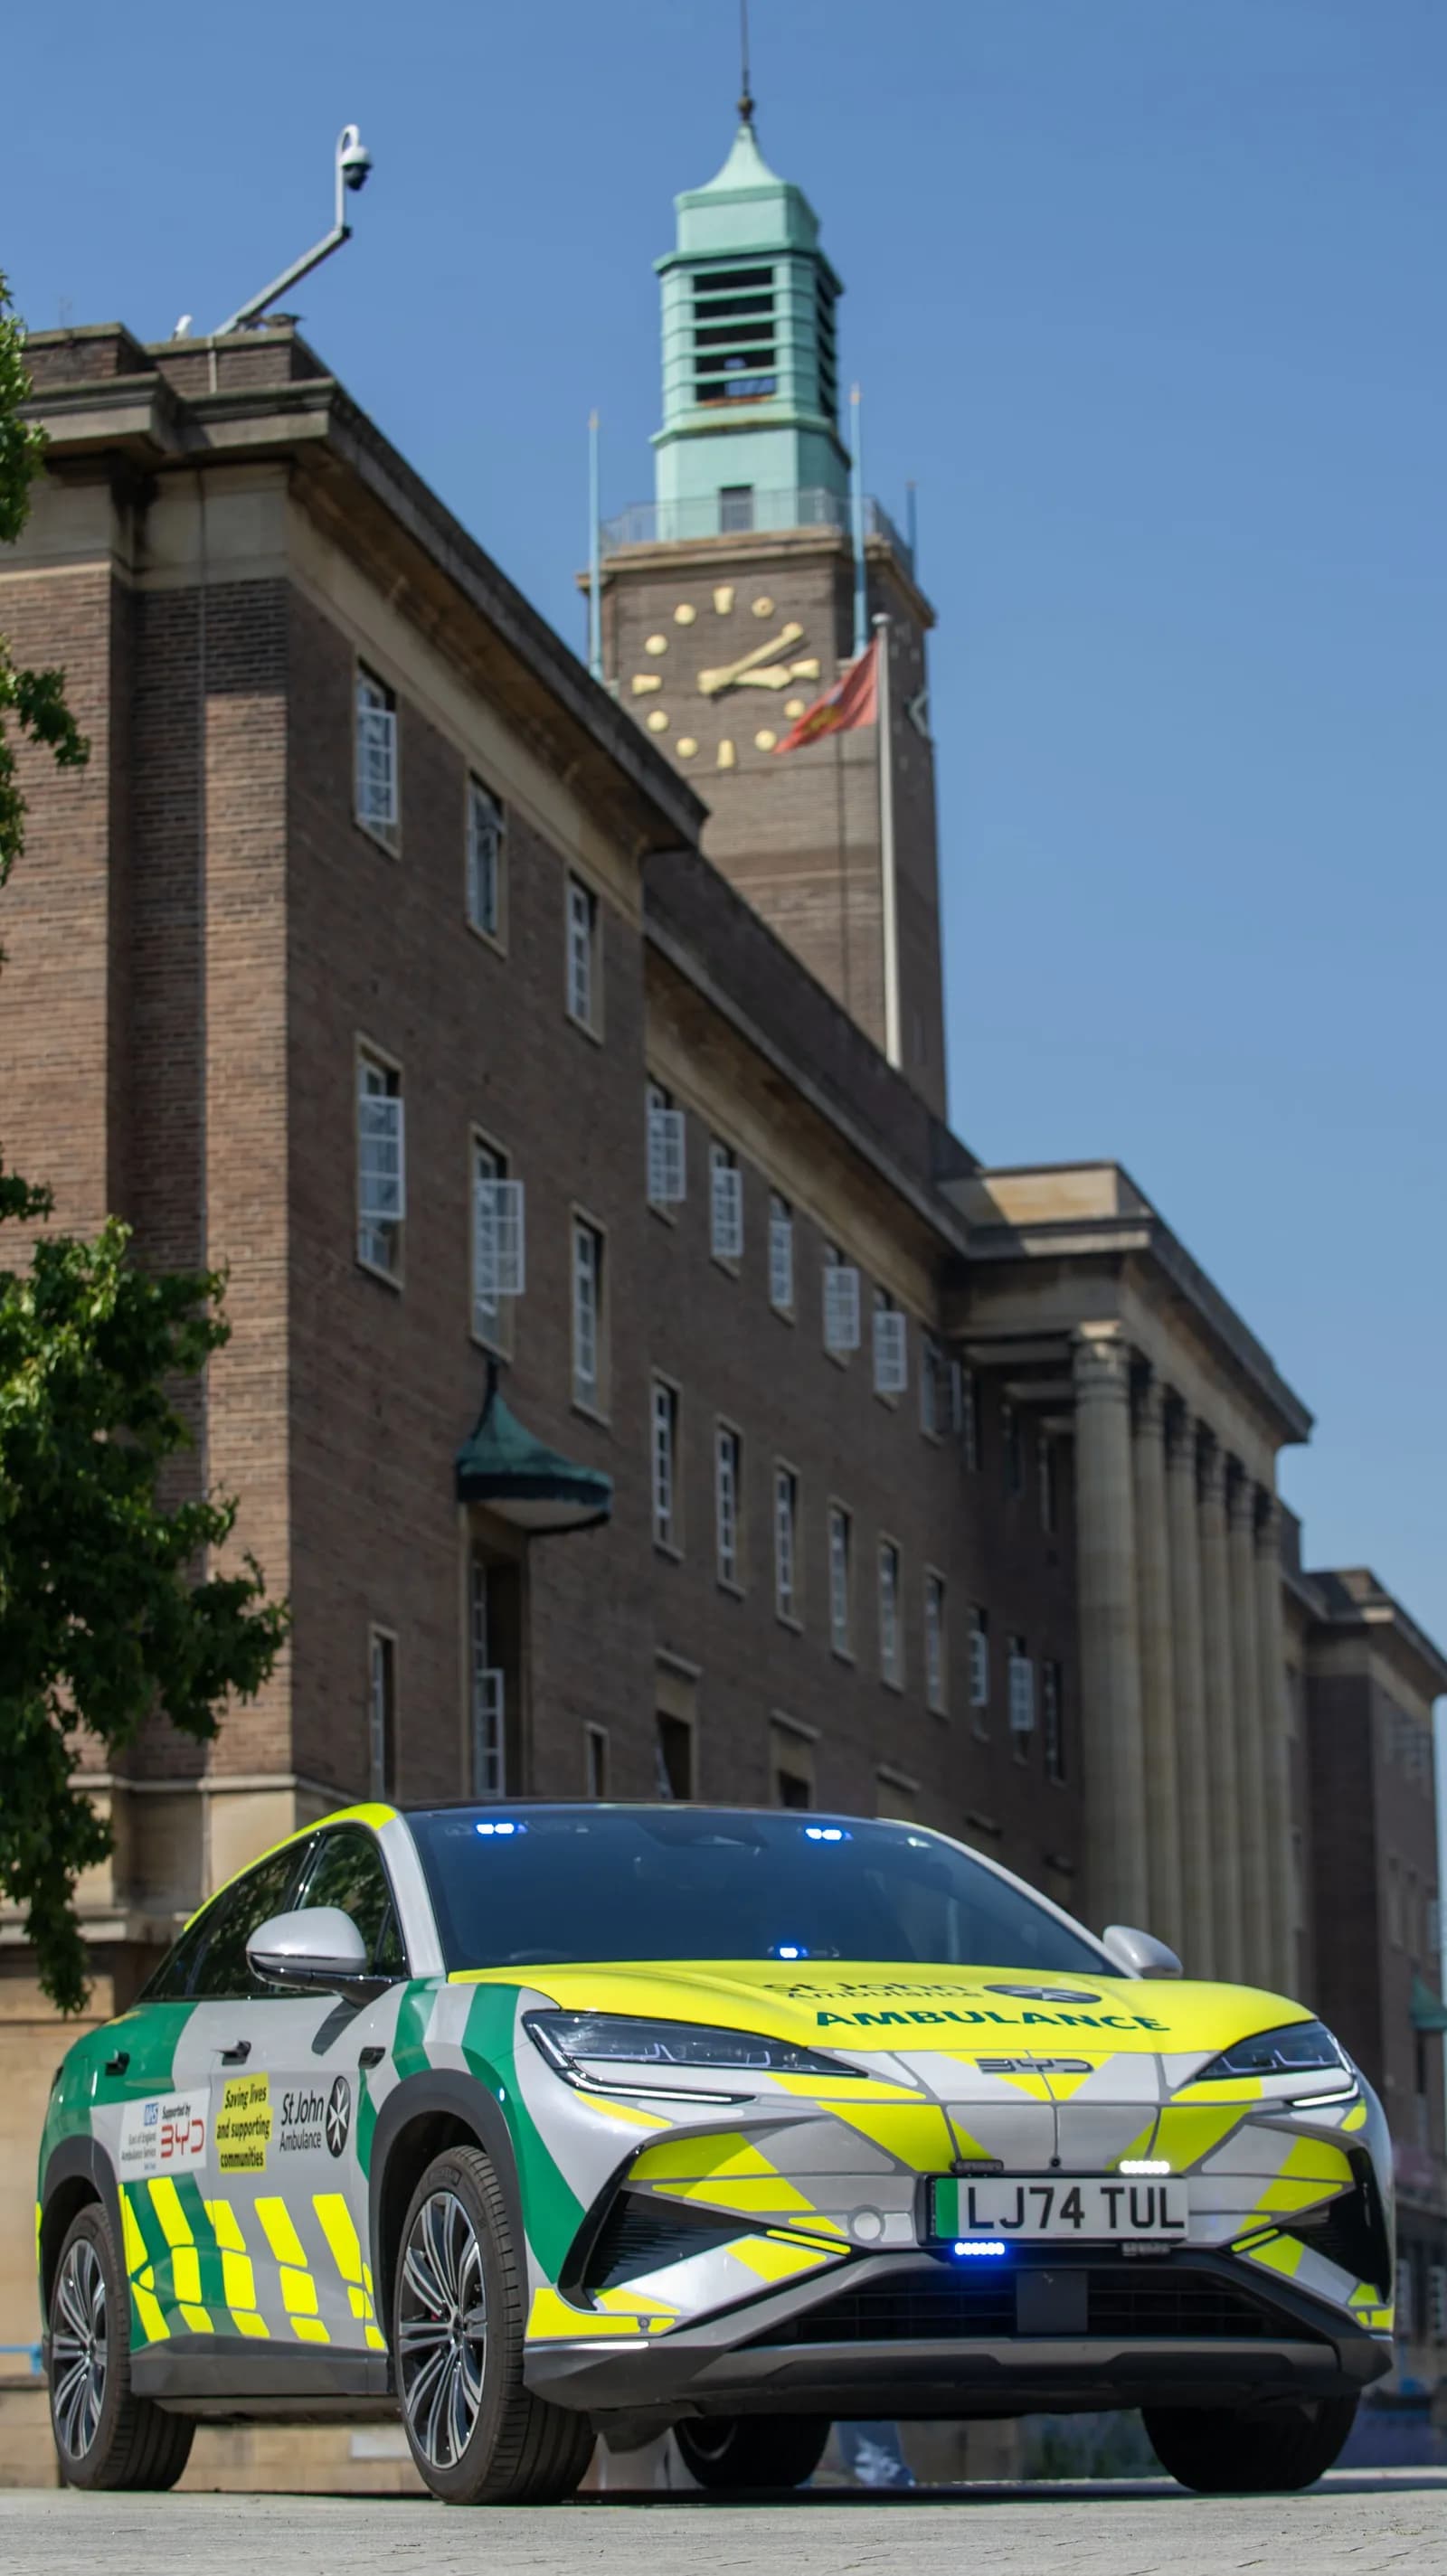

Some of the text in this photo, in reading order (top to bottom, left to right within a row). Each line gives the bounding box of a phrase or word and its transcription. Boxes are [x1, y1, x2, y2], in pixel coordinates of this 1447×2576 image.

[762, 1982, 968, 1993] St John
[817, 2010, 1171, 2032] AMBULANCE
[973, 2058, 1095, 2074] BYD
[224, 2083, 267, 2110] Saving lives
[280, 2090, 325, 2127] St John
[161, 2118, 204, 2159] BYD
[217, 2113, 270, 2142] and supporting
[279, 2128, 322, 2153] Ambulance
[220, 2146, 264, 2168] communities
[968, 2186, 1085, 2230] LJ74
[1100, 2186, 1185, 2230] TUL
